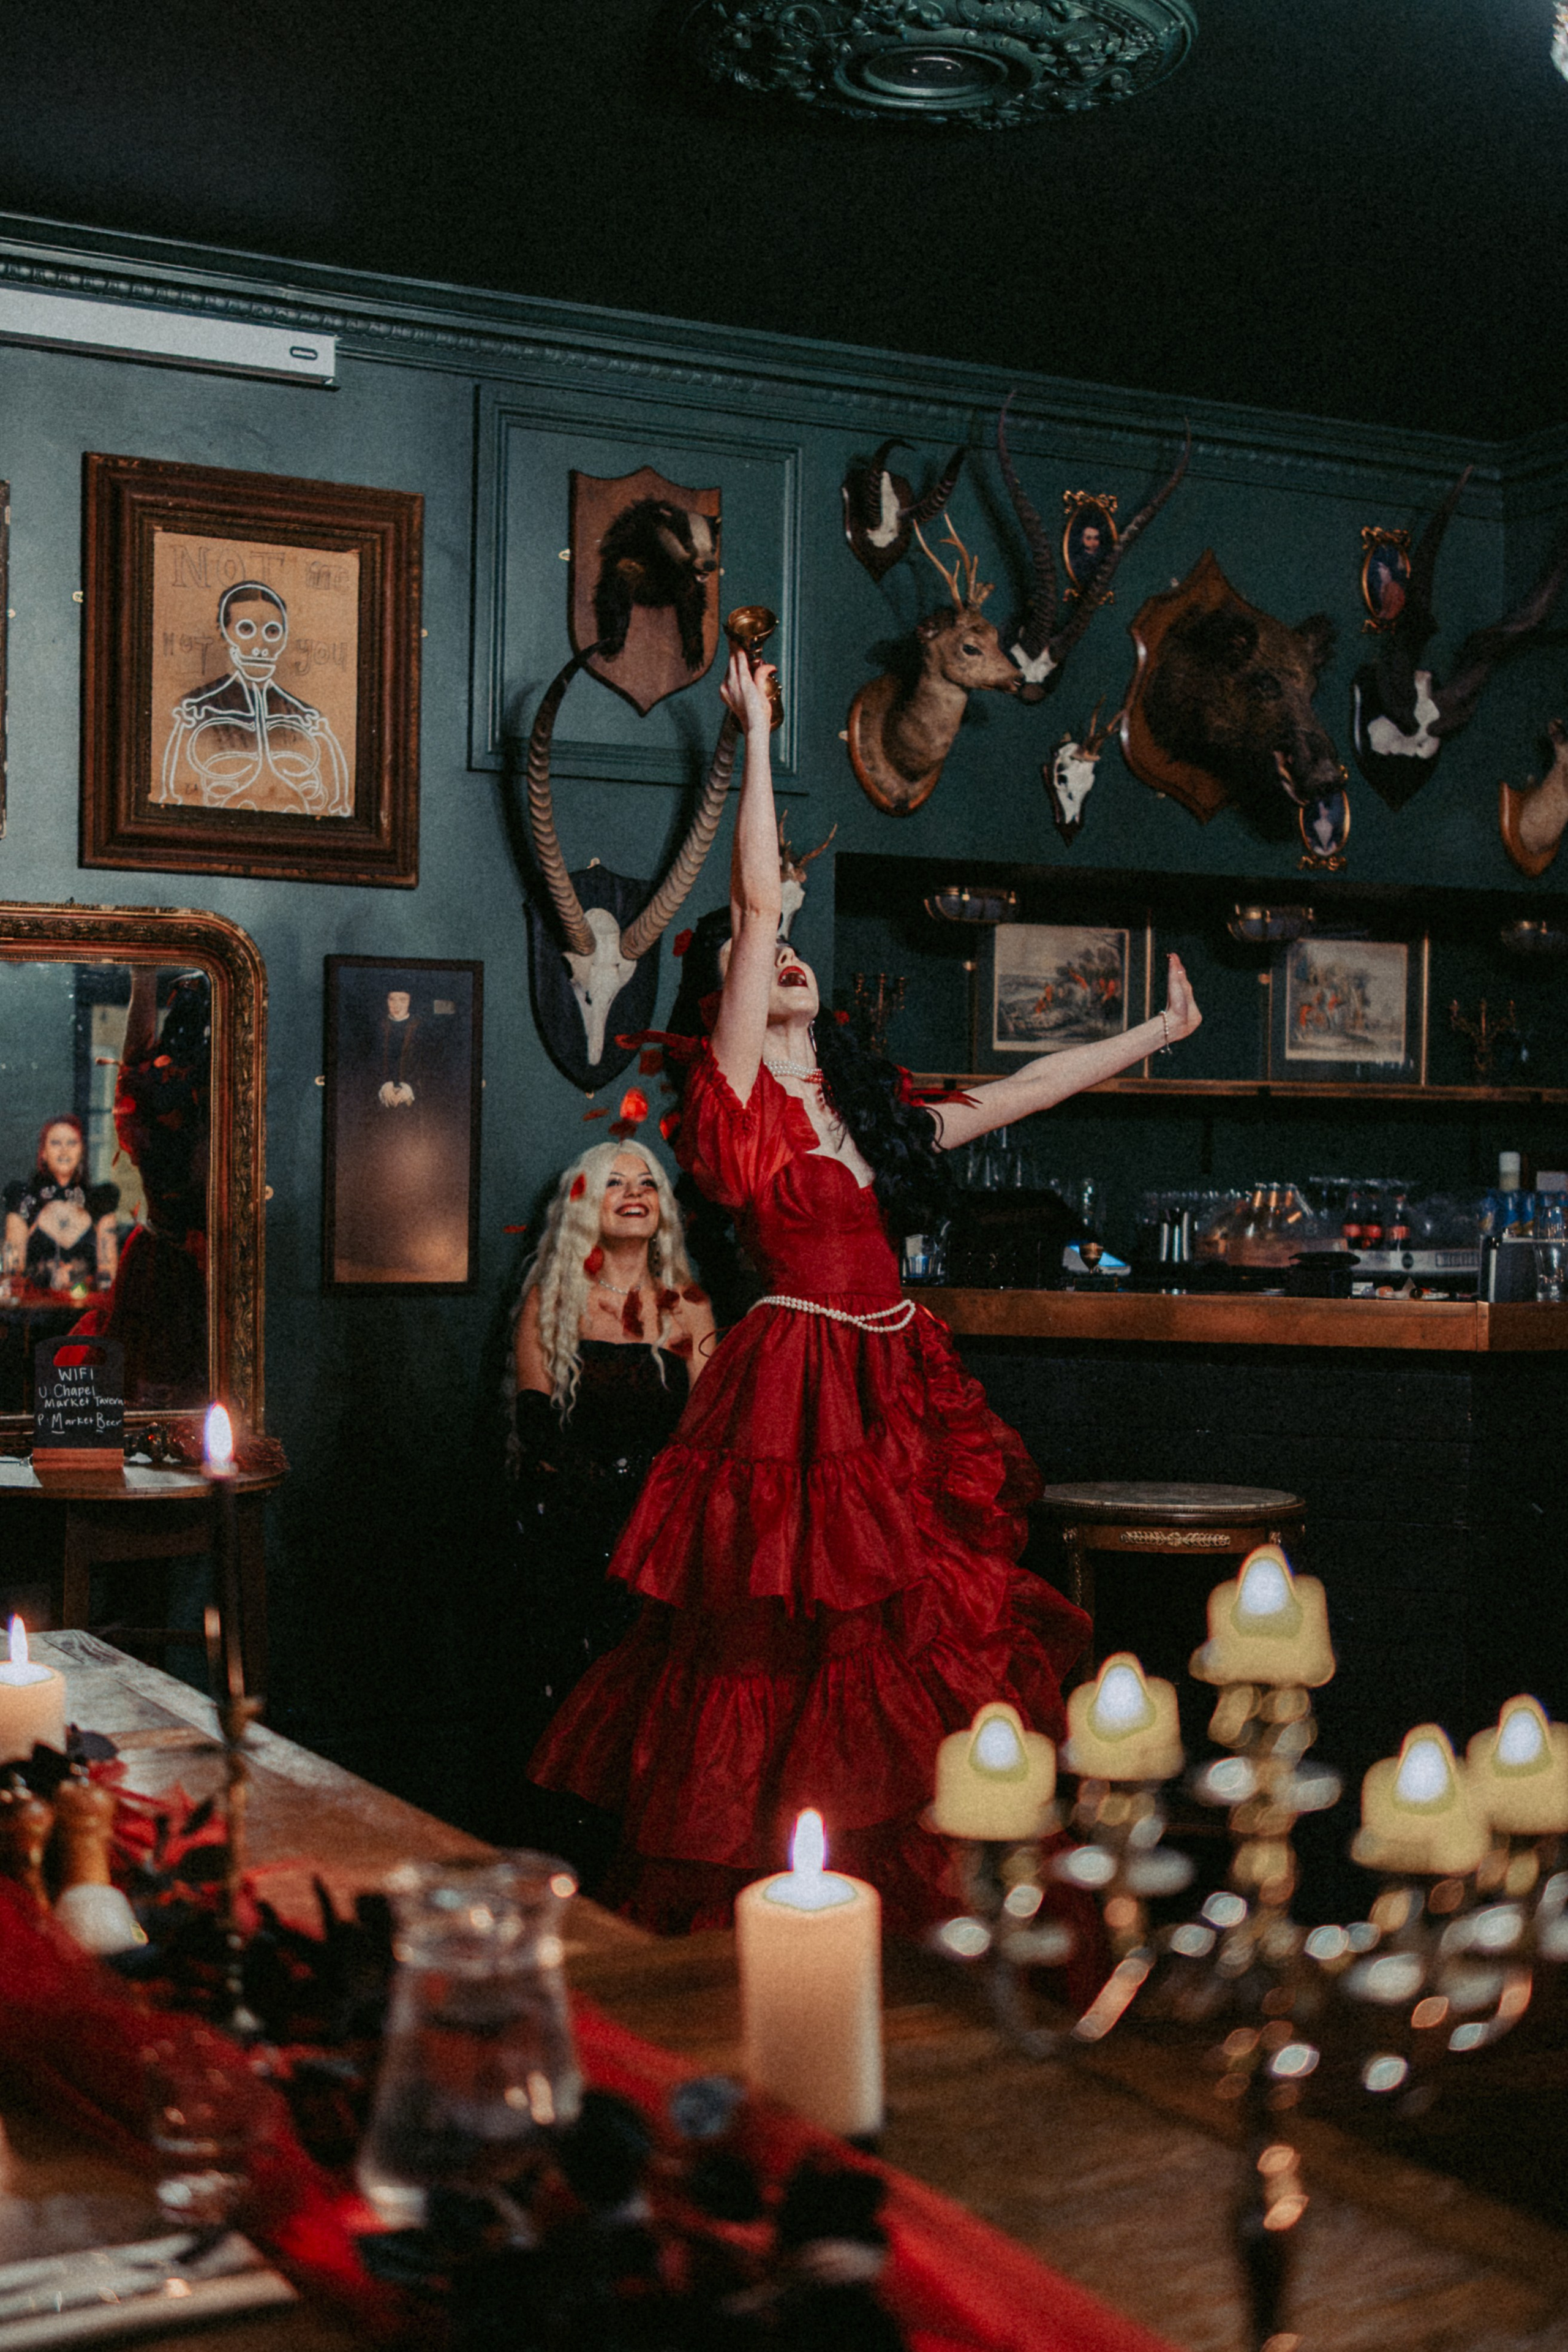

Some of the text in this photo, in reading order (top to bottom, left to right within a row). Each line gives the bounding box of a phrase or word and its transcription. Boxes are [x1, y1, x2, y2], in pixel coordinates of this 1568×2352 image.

[170, 545, 285, 589] NOT
[58, 1367, 94, 1381] WIFI
[53, 1383, 96, 1398] Chapel
[44, 1396, 124, 1408] Market Tavern
[51, 1412, 94, 1430] Market
[96, 1411, 123, 1429] Beer
